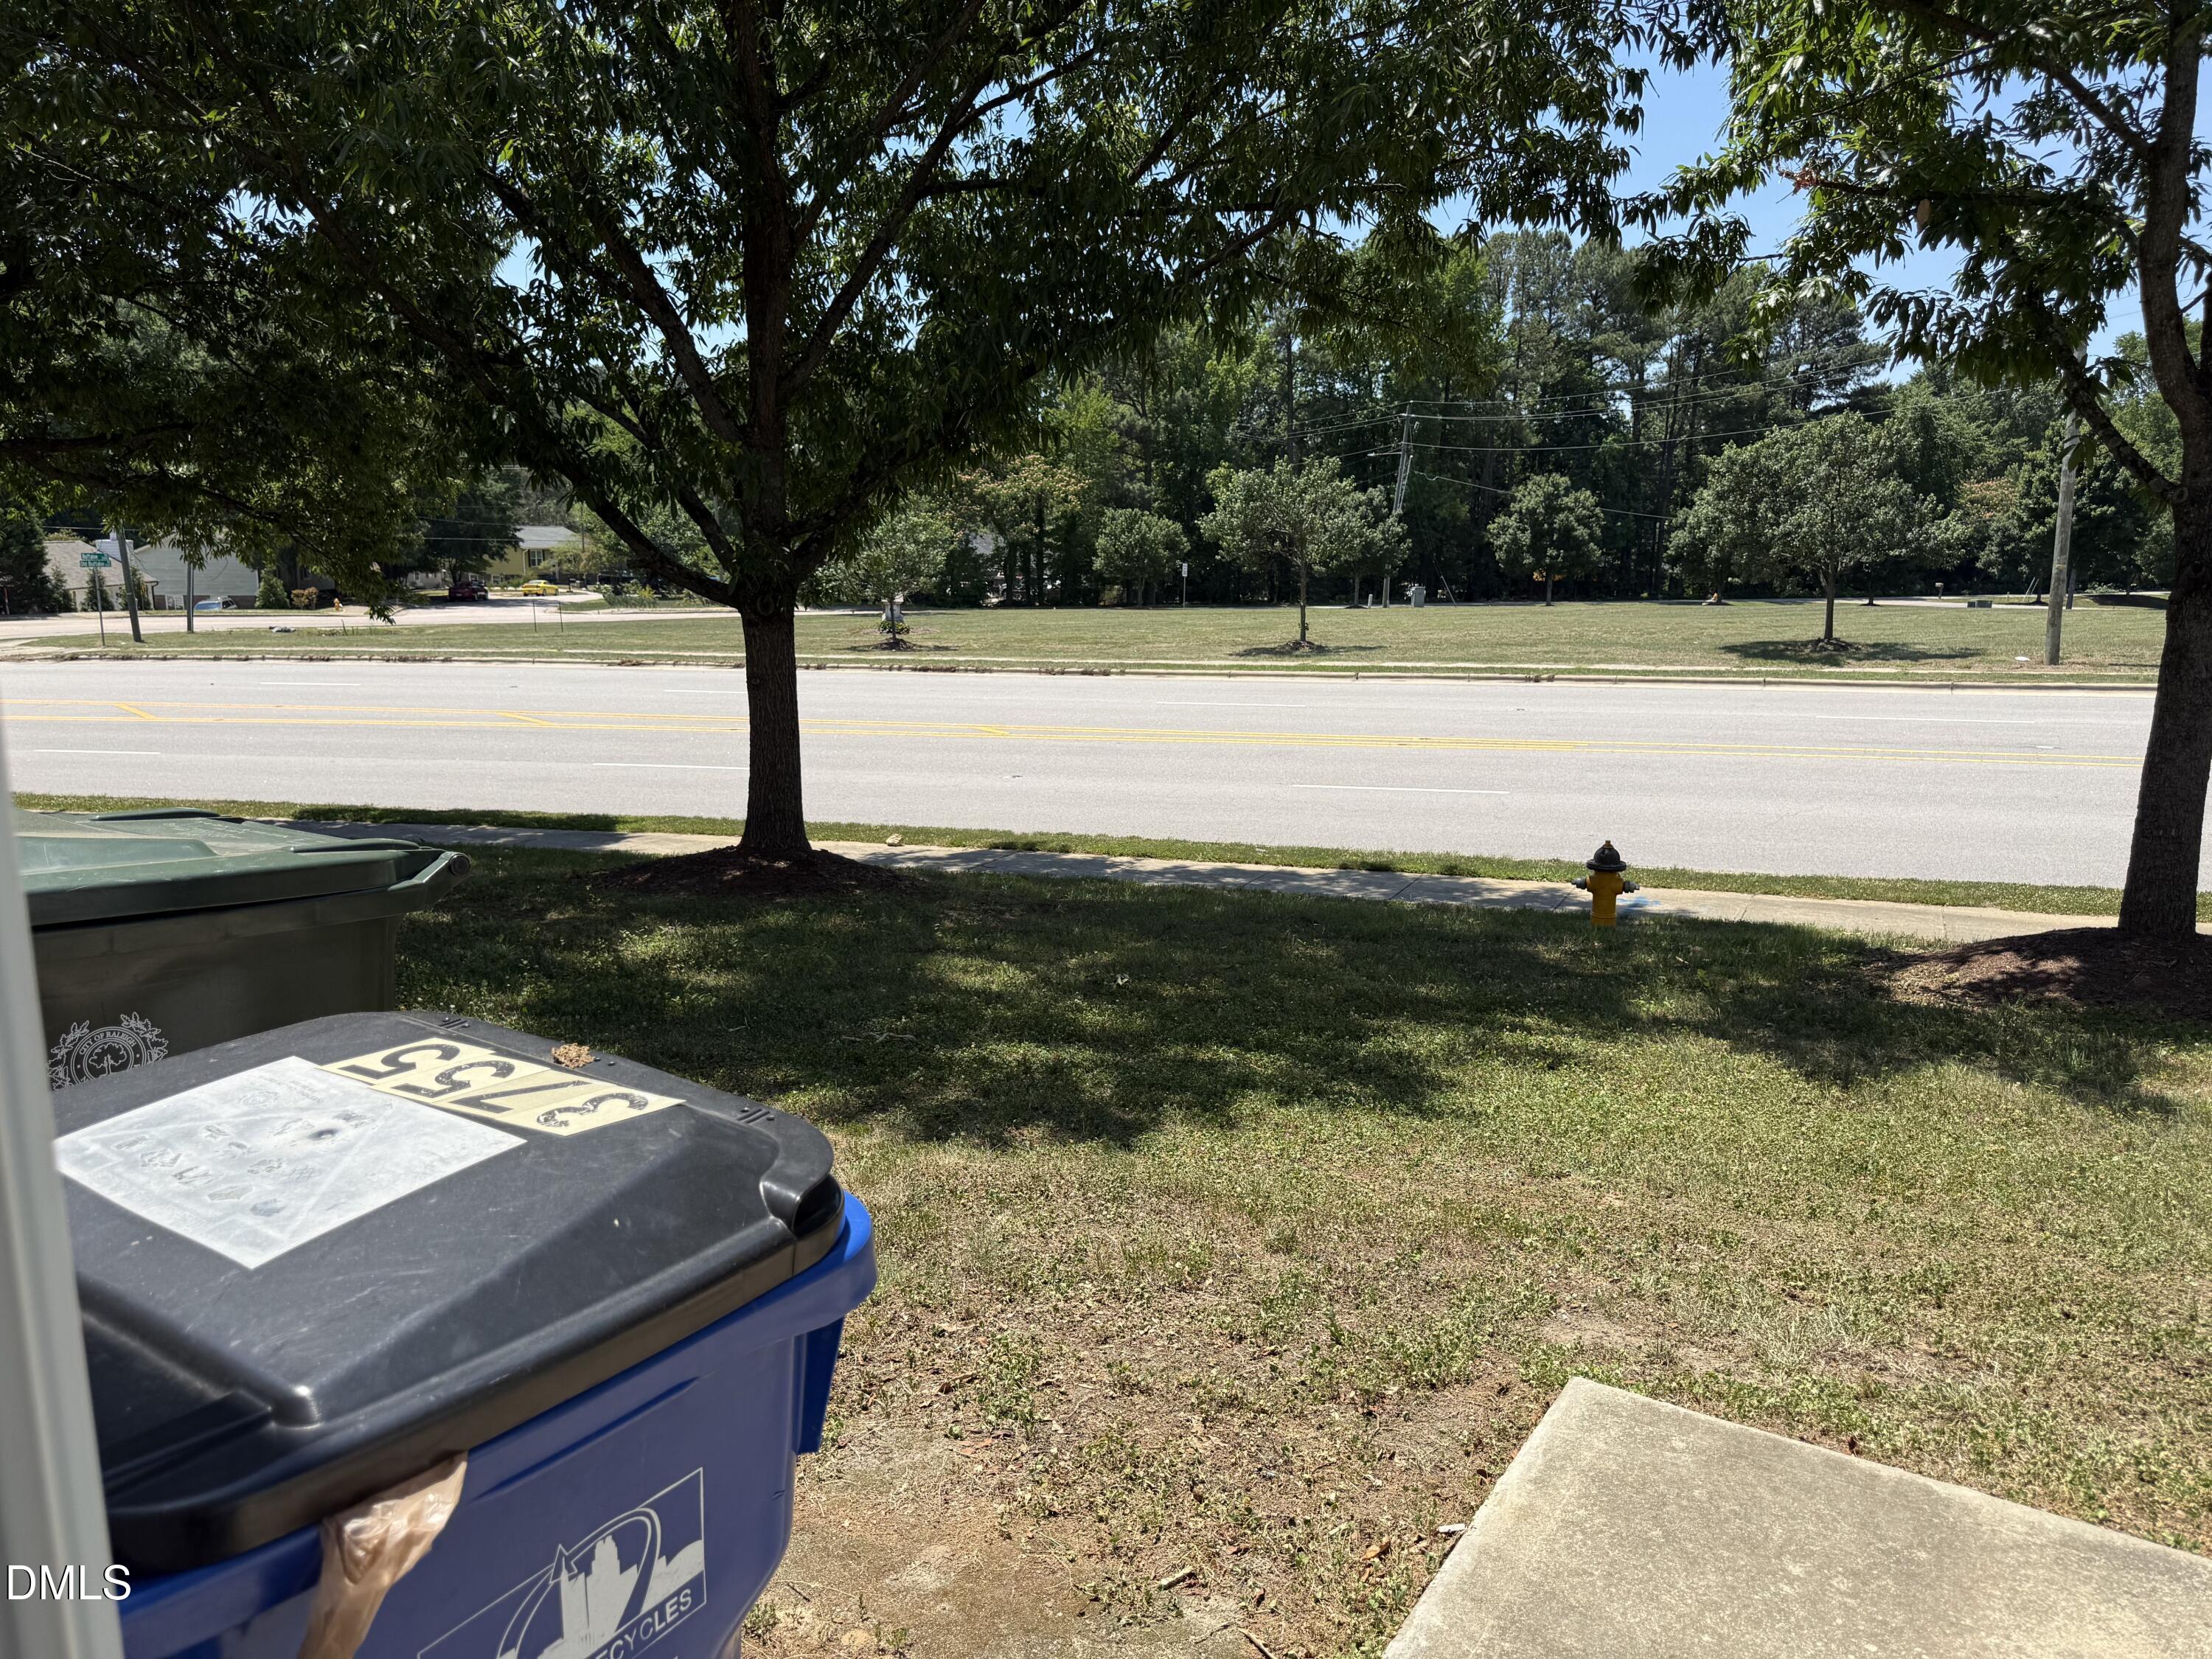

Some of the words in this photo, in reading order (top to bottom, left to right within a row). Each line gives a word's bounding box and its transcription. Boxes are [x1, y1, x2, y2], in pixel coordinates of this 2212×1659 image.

[79, 1039, 94, 1055] CITY
[94, 1032, 105, 1041] OF
[105, 1032, 137, 1047] RALEIGH
[337, 1043, 650, 1128] 3755
